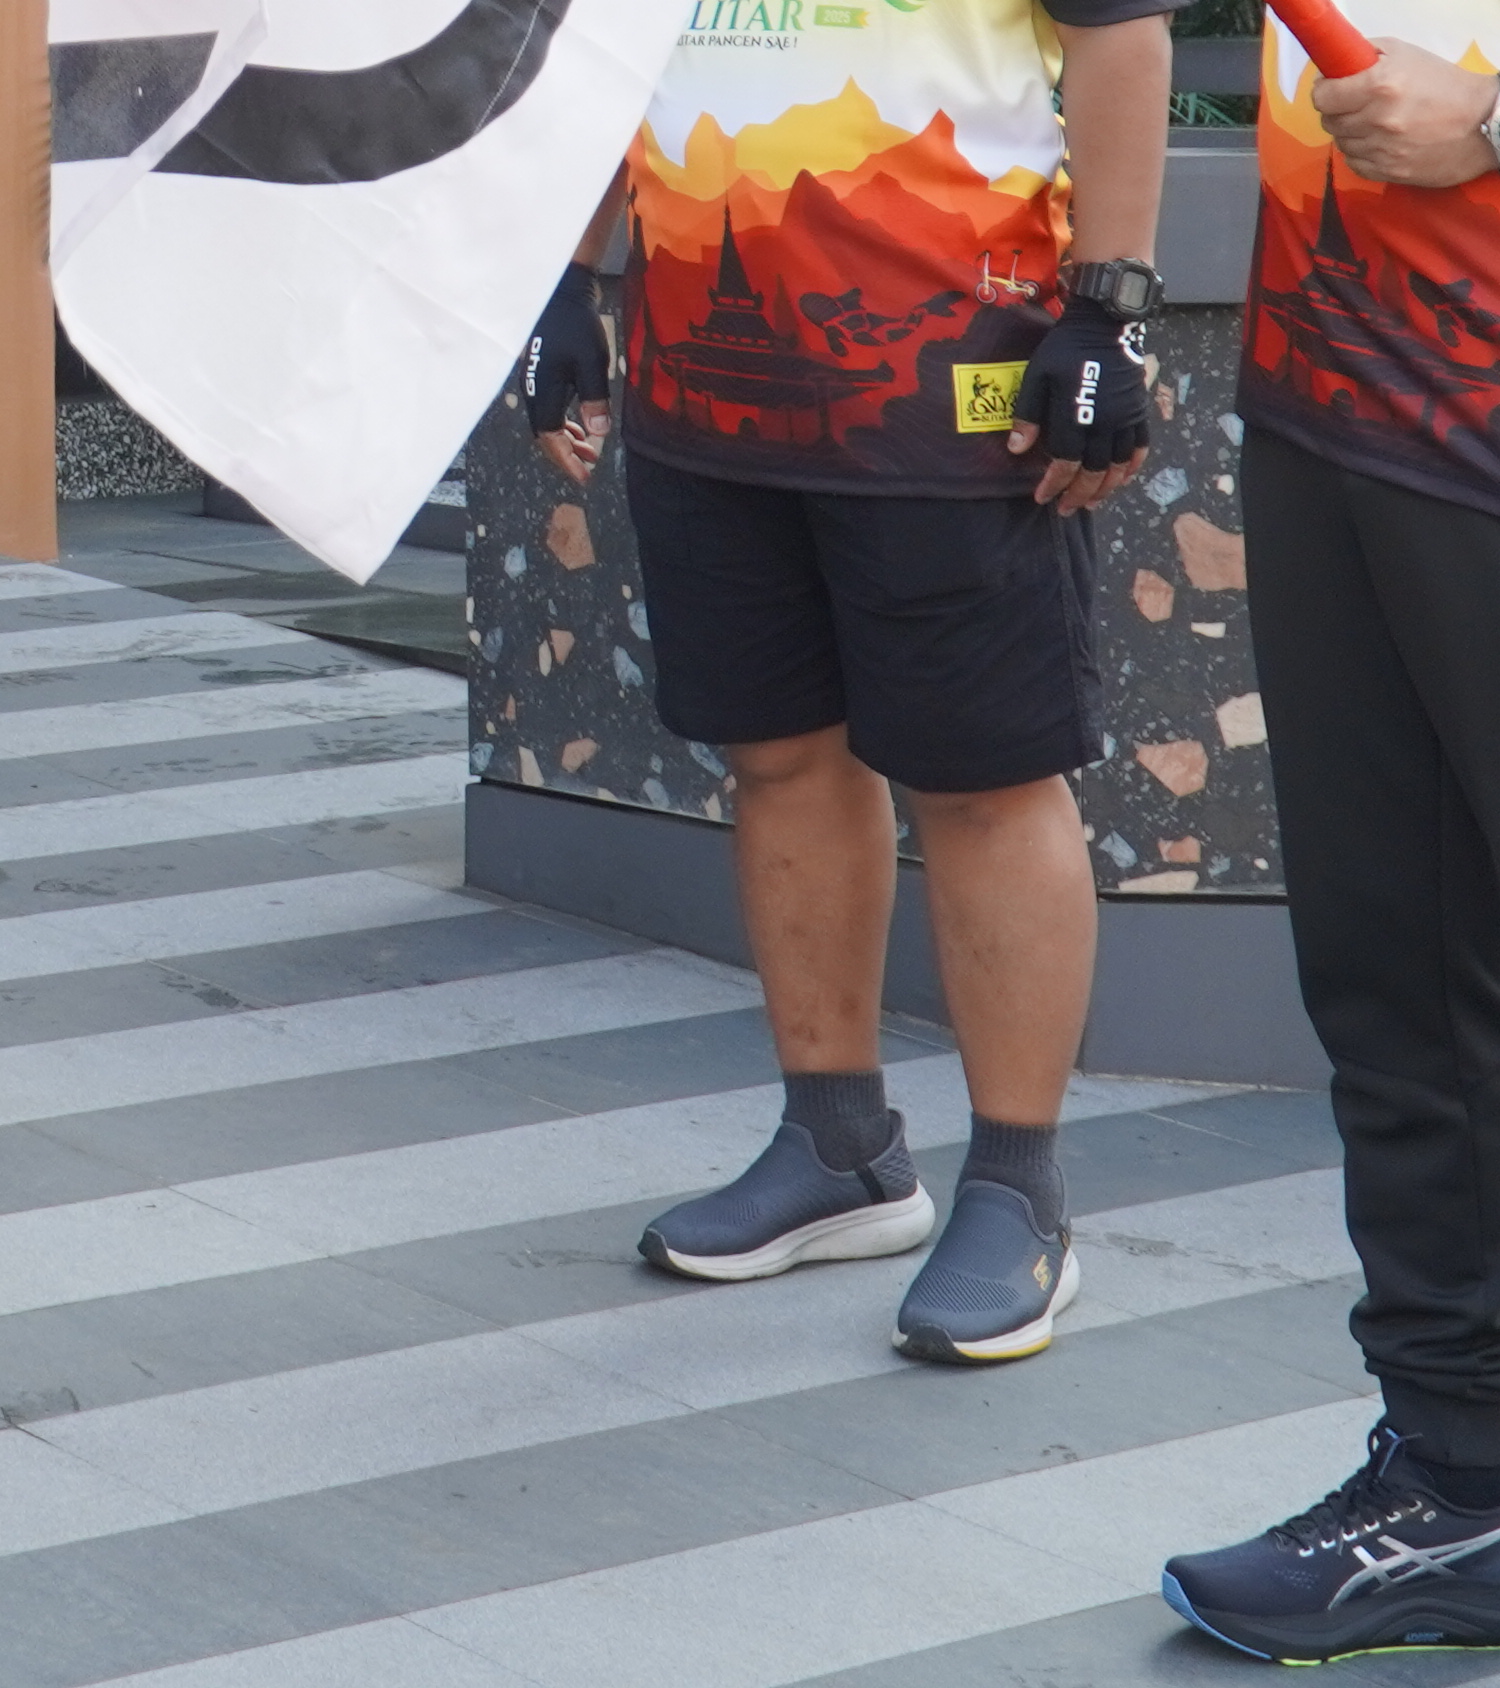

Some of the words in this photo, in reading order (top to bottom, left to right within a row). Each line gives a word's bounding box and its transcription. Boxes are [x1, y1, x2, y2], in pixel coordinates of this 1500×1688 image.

[823, 9, 851, 24] 2025
[708, 34, 762, 48] PANCEN
[764, 36, 792, 51] SAE
